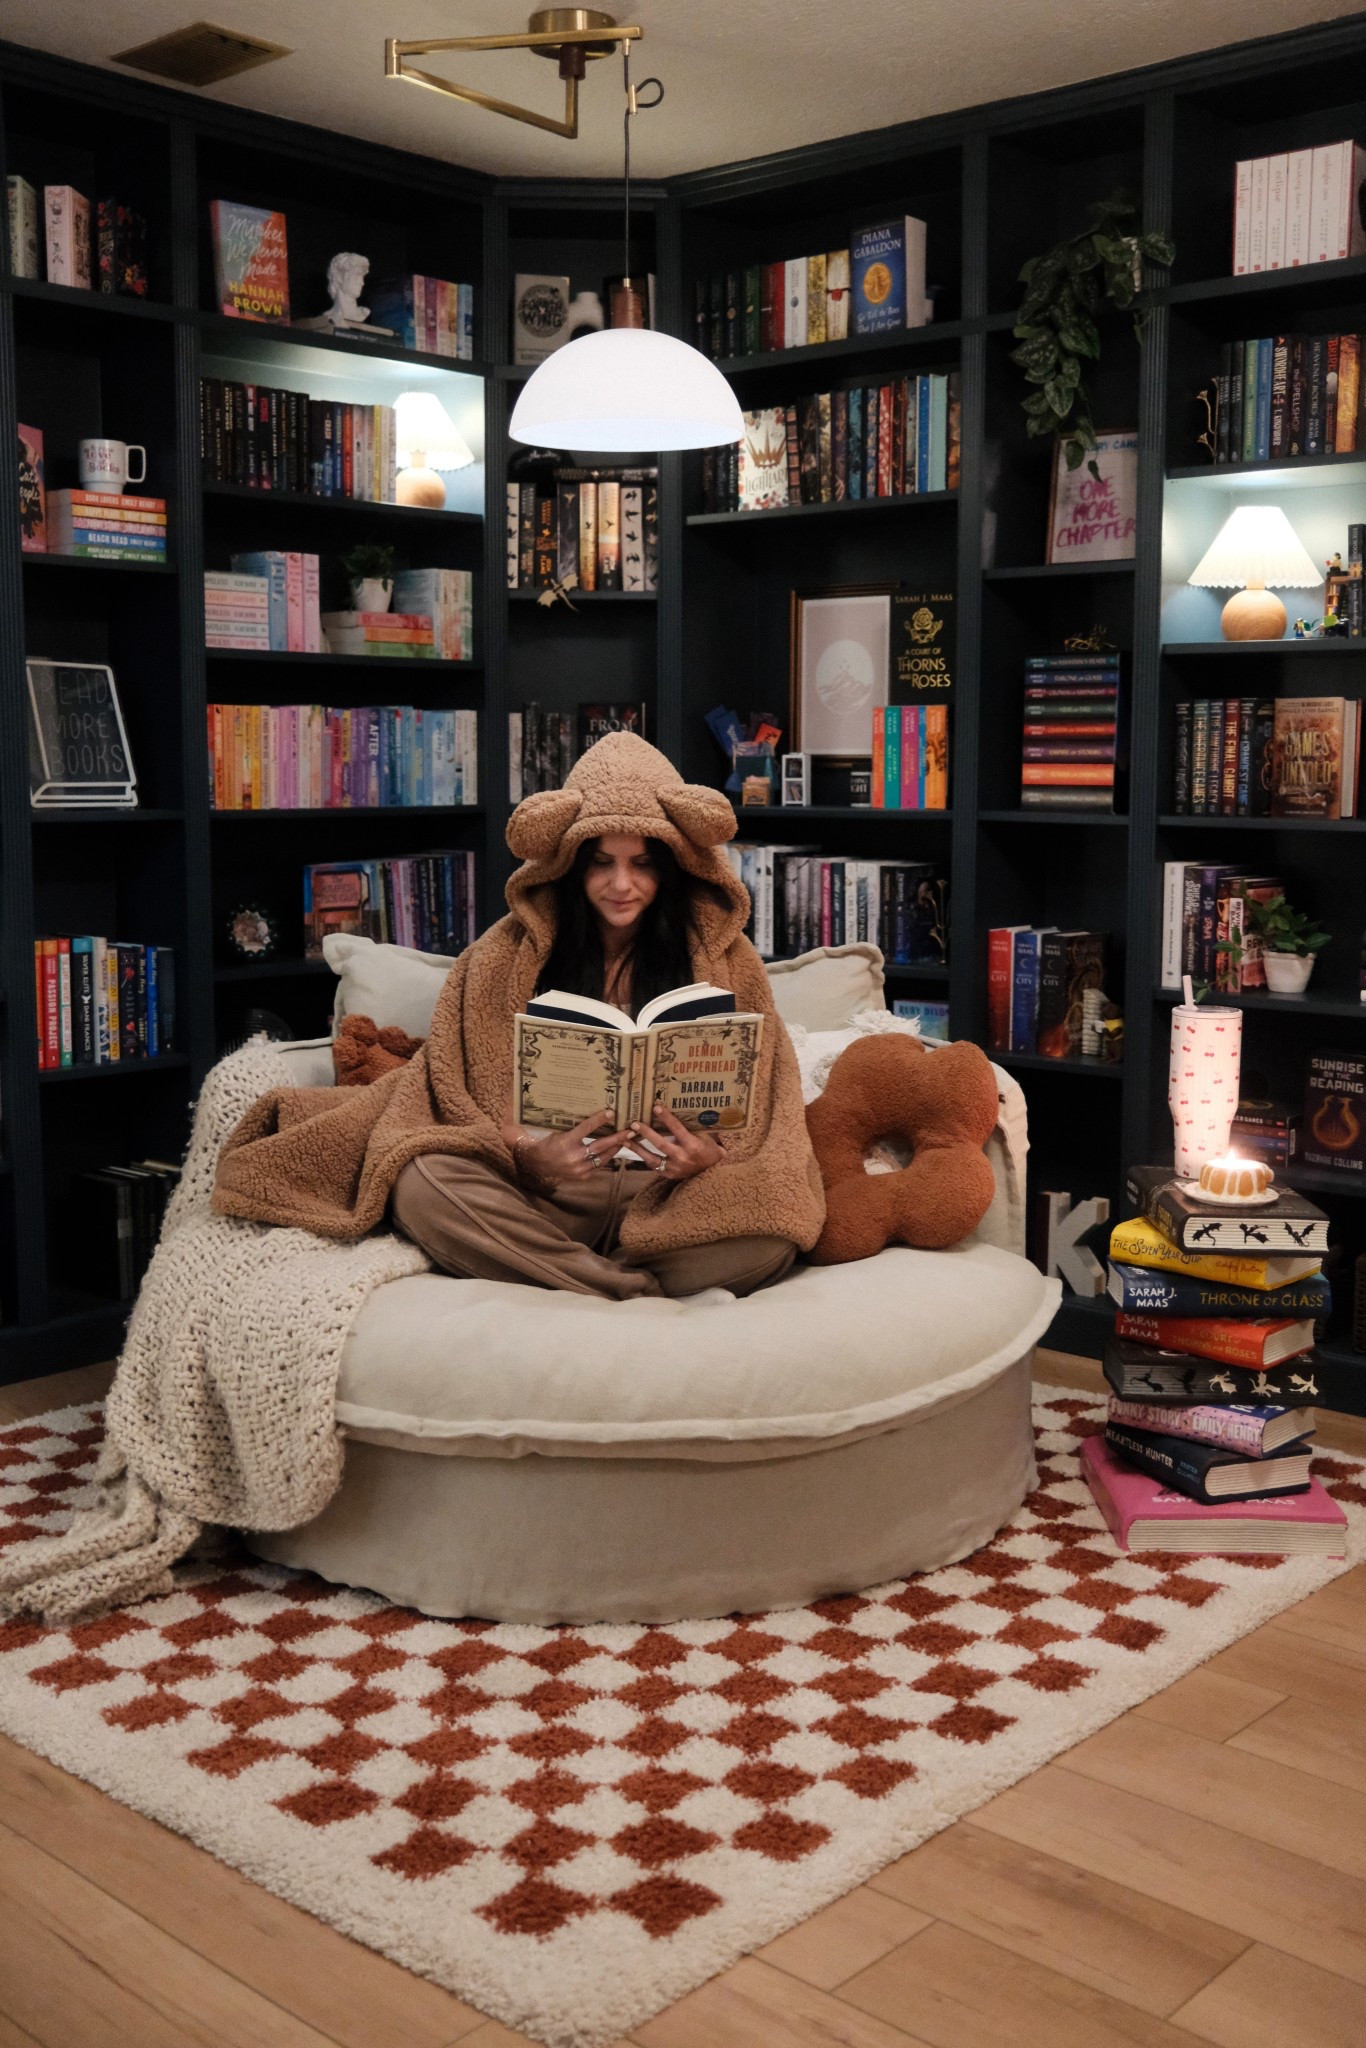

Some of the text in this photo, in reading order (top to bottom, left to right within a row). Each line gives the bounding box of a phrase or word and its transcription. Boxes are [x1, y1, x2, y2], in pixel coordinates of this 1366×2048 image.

[1238, 174, 1248, 208] twilight
[1272, 170, 1283, 202] eclipse
[228, 214, 283, 242] Mistakes
[862, 228, 891, 245] DIANA
[248, 241, 288, 262] Never
[854, 238, 901, 259] GABALDON
[237, 261, 278, 281] Made
[229, 281, 285, 303] HANNAH
[233, 296, 282, 316] BROWN
[523, 298, 562, 312] FOURTH
[524, 313, 562, 328] WING
[1328, 339, 1338, 370] BRIDE
[1272, 346, 1288, 395] SWORDHEART
[1311, 342, 1320, 415] HEAVENLY BODIES
[1292, 382, 1300, 432] SPELLSHOP
[1079, 475, 1115, 501] ONE
[1072, 500, 1122, 524] MORE
[88, 532, 128, 545] BEACH READ
[1056, 516, 1136, 548] CHAPTER
[895, 595, 920, 603] SARAH
[898, 656, 946, 672] THORNS
[912, 674, 951, 690] ROSES
[50, 712, 110, 739] MORE
[369, 724, 379, 756] AFTER
[1285, 731, 1330, 757] GAMES
[50, 744, 124, 776] BOOKS
[1193, 717, 1207, 804] THE INHERITANCE GAMES
[1223, 721, 1237, 798] THE FINAL GAMBIT
[1238, 741, 1250, 806] GRANDEST GAME
[1281, 760, 1331, 786] UNTOLD
[1208, 775, 1219, 803] LEGACY
[1185, 880, 1193, 915] SPARROWS
[1192, 883, 1200, 907] SHIELD
[1044, 948, 1061, 956] MAAS
[991, 974, 1007, 982] CITY
[1016, 977, 1032, 985] CITY
[1043, 978, 1059, 986] CITY
[47, 979, 58, 1050] PASSION PROJECT
[689, 1044, 724, 1057] DEMON
[673, 1060, 736, 1074] COPPERHEAD
[1311, 1058, 1364, 1074] SUNRISE
[1323, 1070, 1351, 1080] ON THE
[681, 1081, 724, 1094] BARBARA
[1310, 1077, 1364, 1094] REAPING
[672, 1096, 731, 1108] KINGSOLVER
[1334, 1158, 1364, 1170] COLLINS
[1113, 1239, 1128, 1250] THE
[1128, 1238, 1158, 1255] SEVEN
[1158, 1243, 1180, 1260] YEAR
[1129, 1288, 1177, 1298] SARAH J.
[1136, 1299, 1168, 1308] MAAS
[1200, 1292, 1324, 1308] THRONE OF GLASS
[1123, 1314, 1158, 1328] SARAH
[1129, 1328, 1160, 1340] MAAS
[1172, 1335, 1258, 1360] THORNS ROSES
[1110, 1399, 1180, 1426] FUNNY STORY
[1192, 1416, 1260, 1442] EMILY HENRY
[1106, 1428, 1174, 1469] HEARTLESS HUNTER
